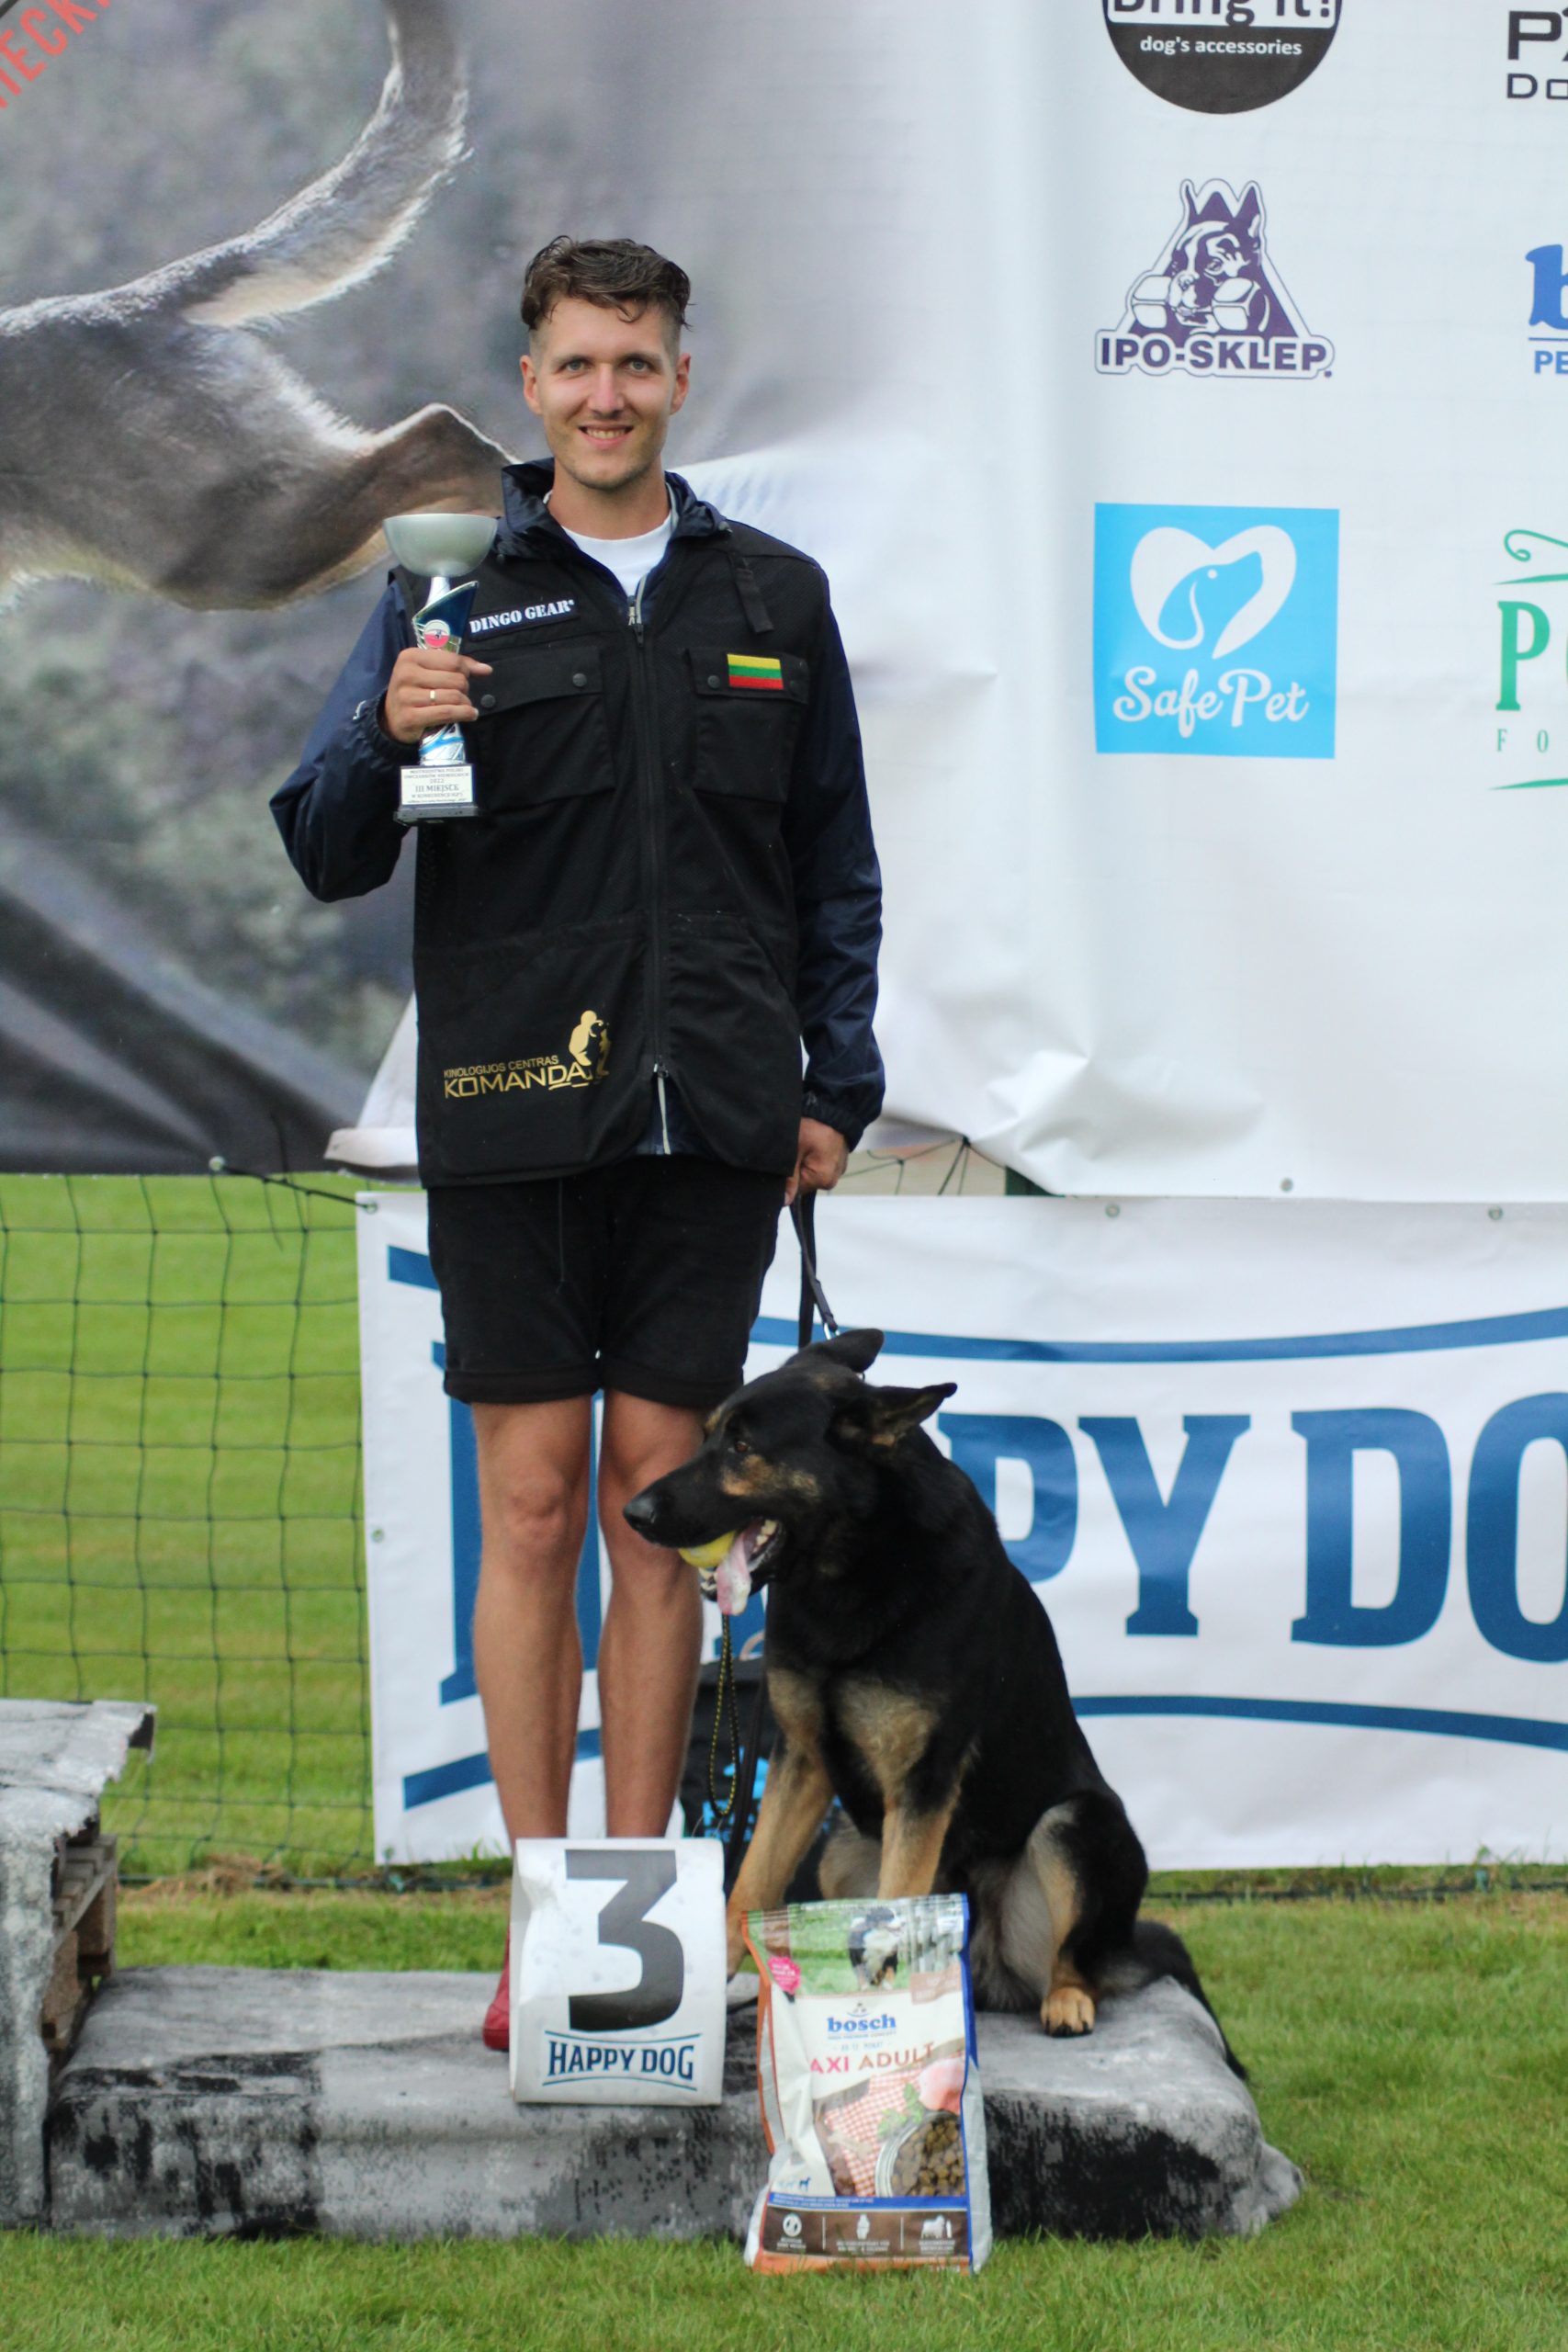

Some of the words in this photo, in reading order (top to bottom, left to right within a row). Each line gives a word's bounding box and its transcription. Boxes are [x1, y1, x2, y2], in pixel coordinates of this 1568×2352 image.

[1140, 36, 1190, 55] dog's
[1195, 39, 1303, 55] accessories
[469, 610, 523, 633] DINGO
[444, 1062, 506, 1079] KINOLOGIJOS
[508, 1055, 559, 1070] CENTRAS
[445, 1061, 592, 1099] KOMANDA
[565, 1849, 684, 2033] 3
[828, 2013, 897, 2033] bosch
[547, 2041, 637, 2076] HAPPY
[640, 2045, 695, 2081] DOG
[810, 2056, 850, 2074] AXI
[858, 2041, 935, 2070] ADULT
